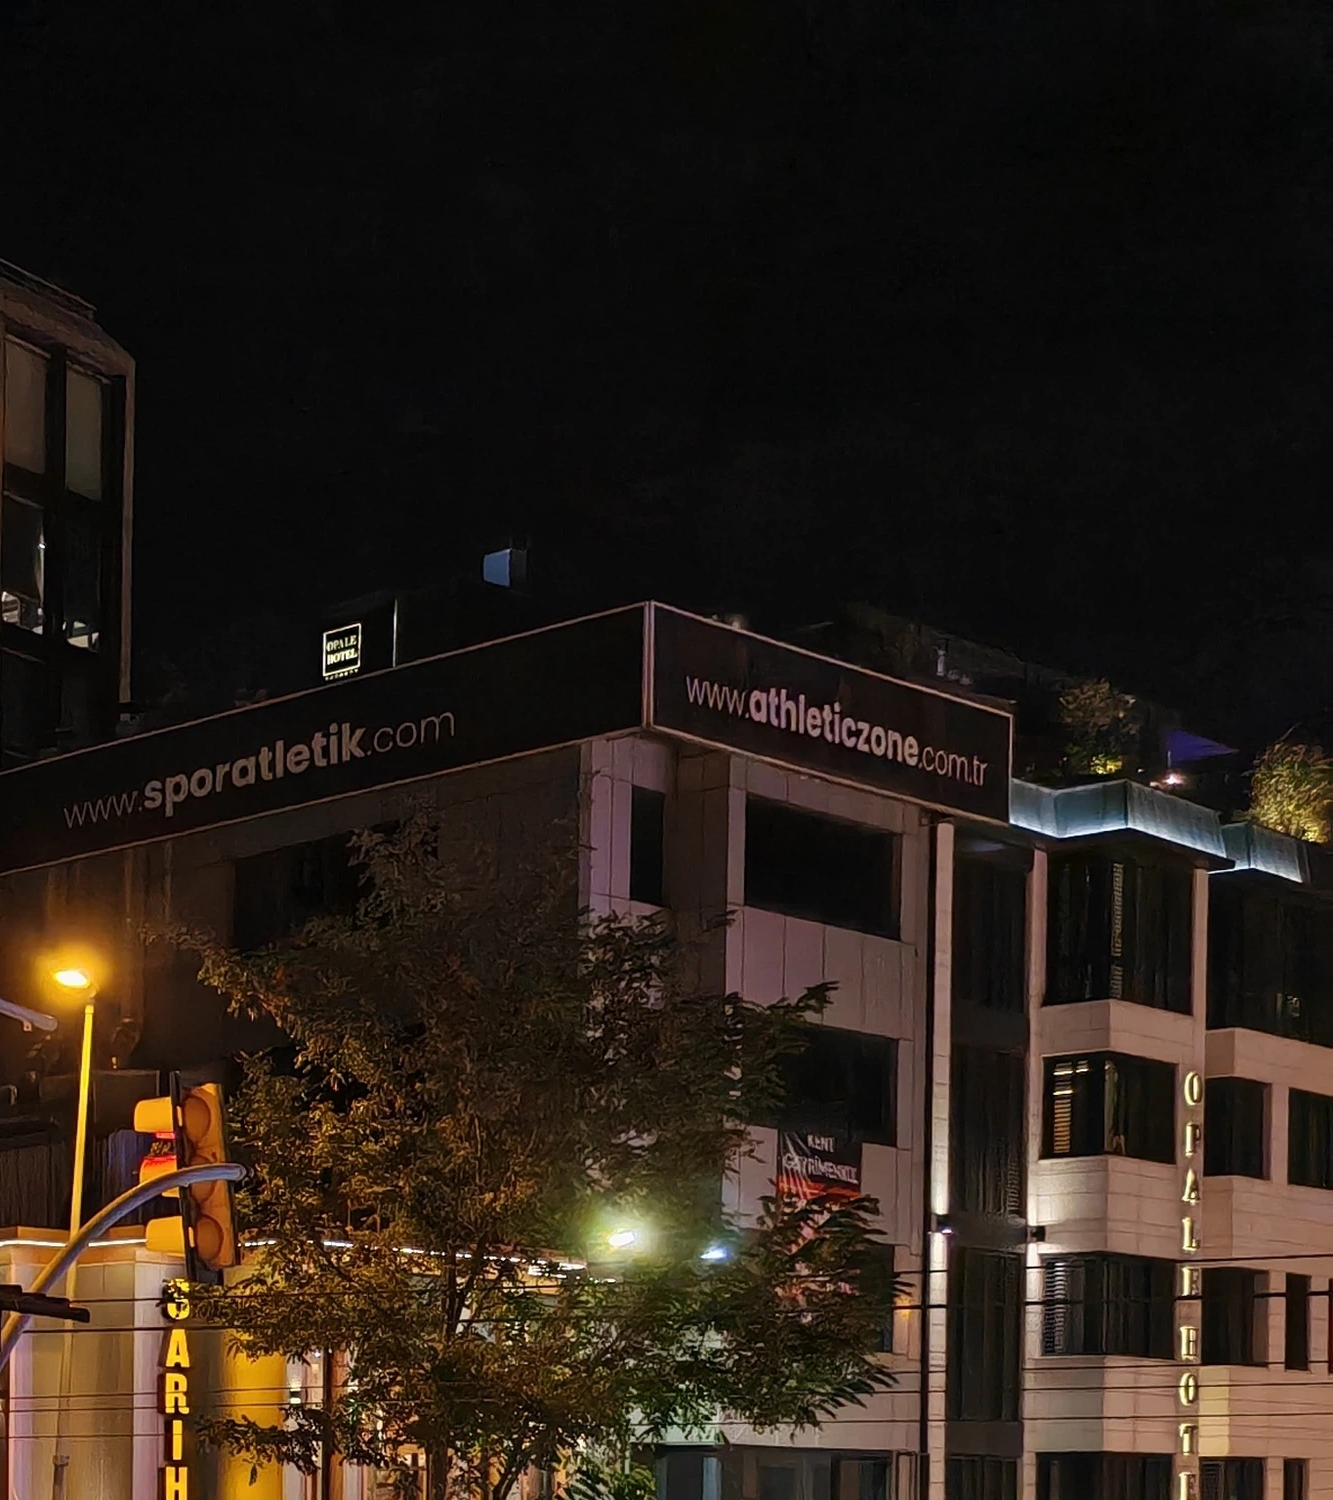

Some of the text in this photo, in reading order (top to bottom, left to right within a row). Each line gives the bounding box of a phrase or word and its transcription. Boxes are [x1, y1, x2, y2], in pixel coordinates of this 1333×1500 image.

[326, 634, 357, 652] OPALE
[327, 647, 358, 666] HOTEL
[685, 675, 988, 787] www.athleticzone.com.tr
[63, 711, 456, 830] www.sporatletik.com
